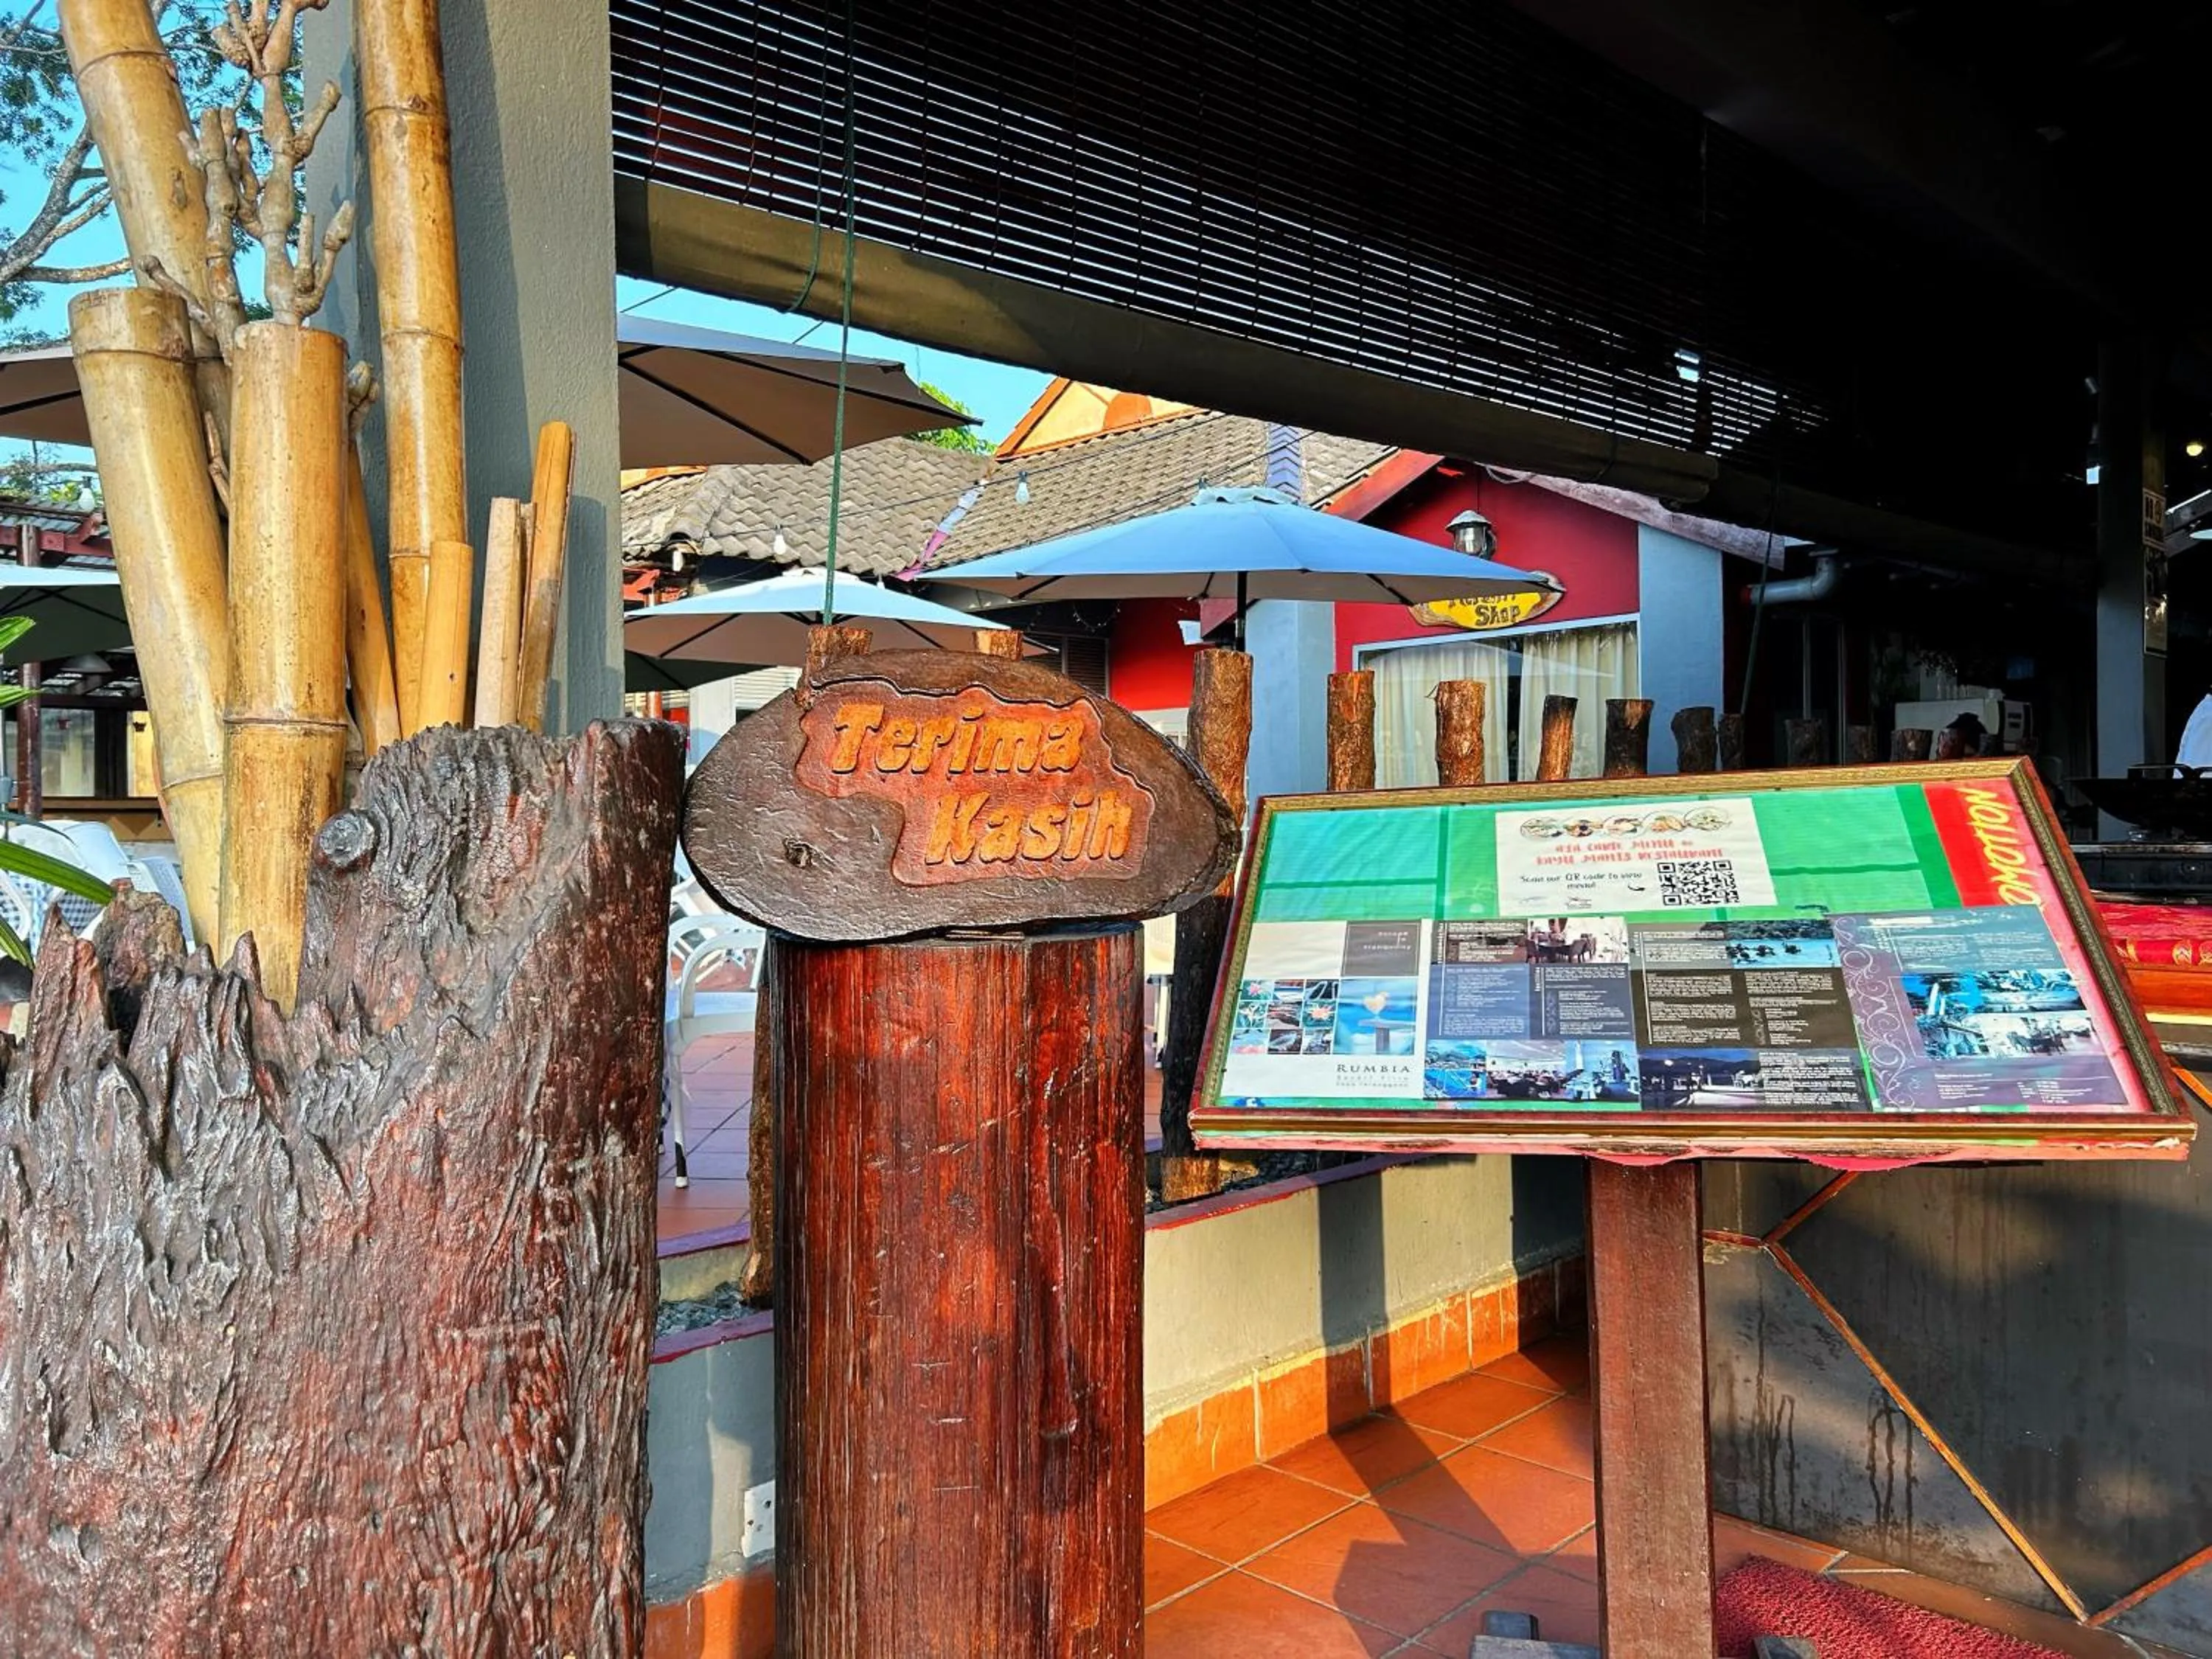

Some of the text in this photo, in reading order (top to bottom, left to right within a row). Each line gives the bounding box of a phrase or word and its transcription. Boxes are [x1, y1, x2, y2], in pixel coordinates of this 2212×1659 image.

[831, 701, 1086, 774] Terima
[925, 790, 1133, 865] Kasih
[1956, 787, 2043, 908] OMOTION
[1565, 873, 1581, 881] QR
[1336, 1063, 1411, 1073] RUMBIA
